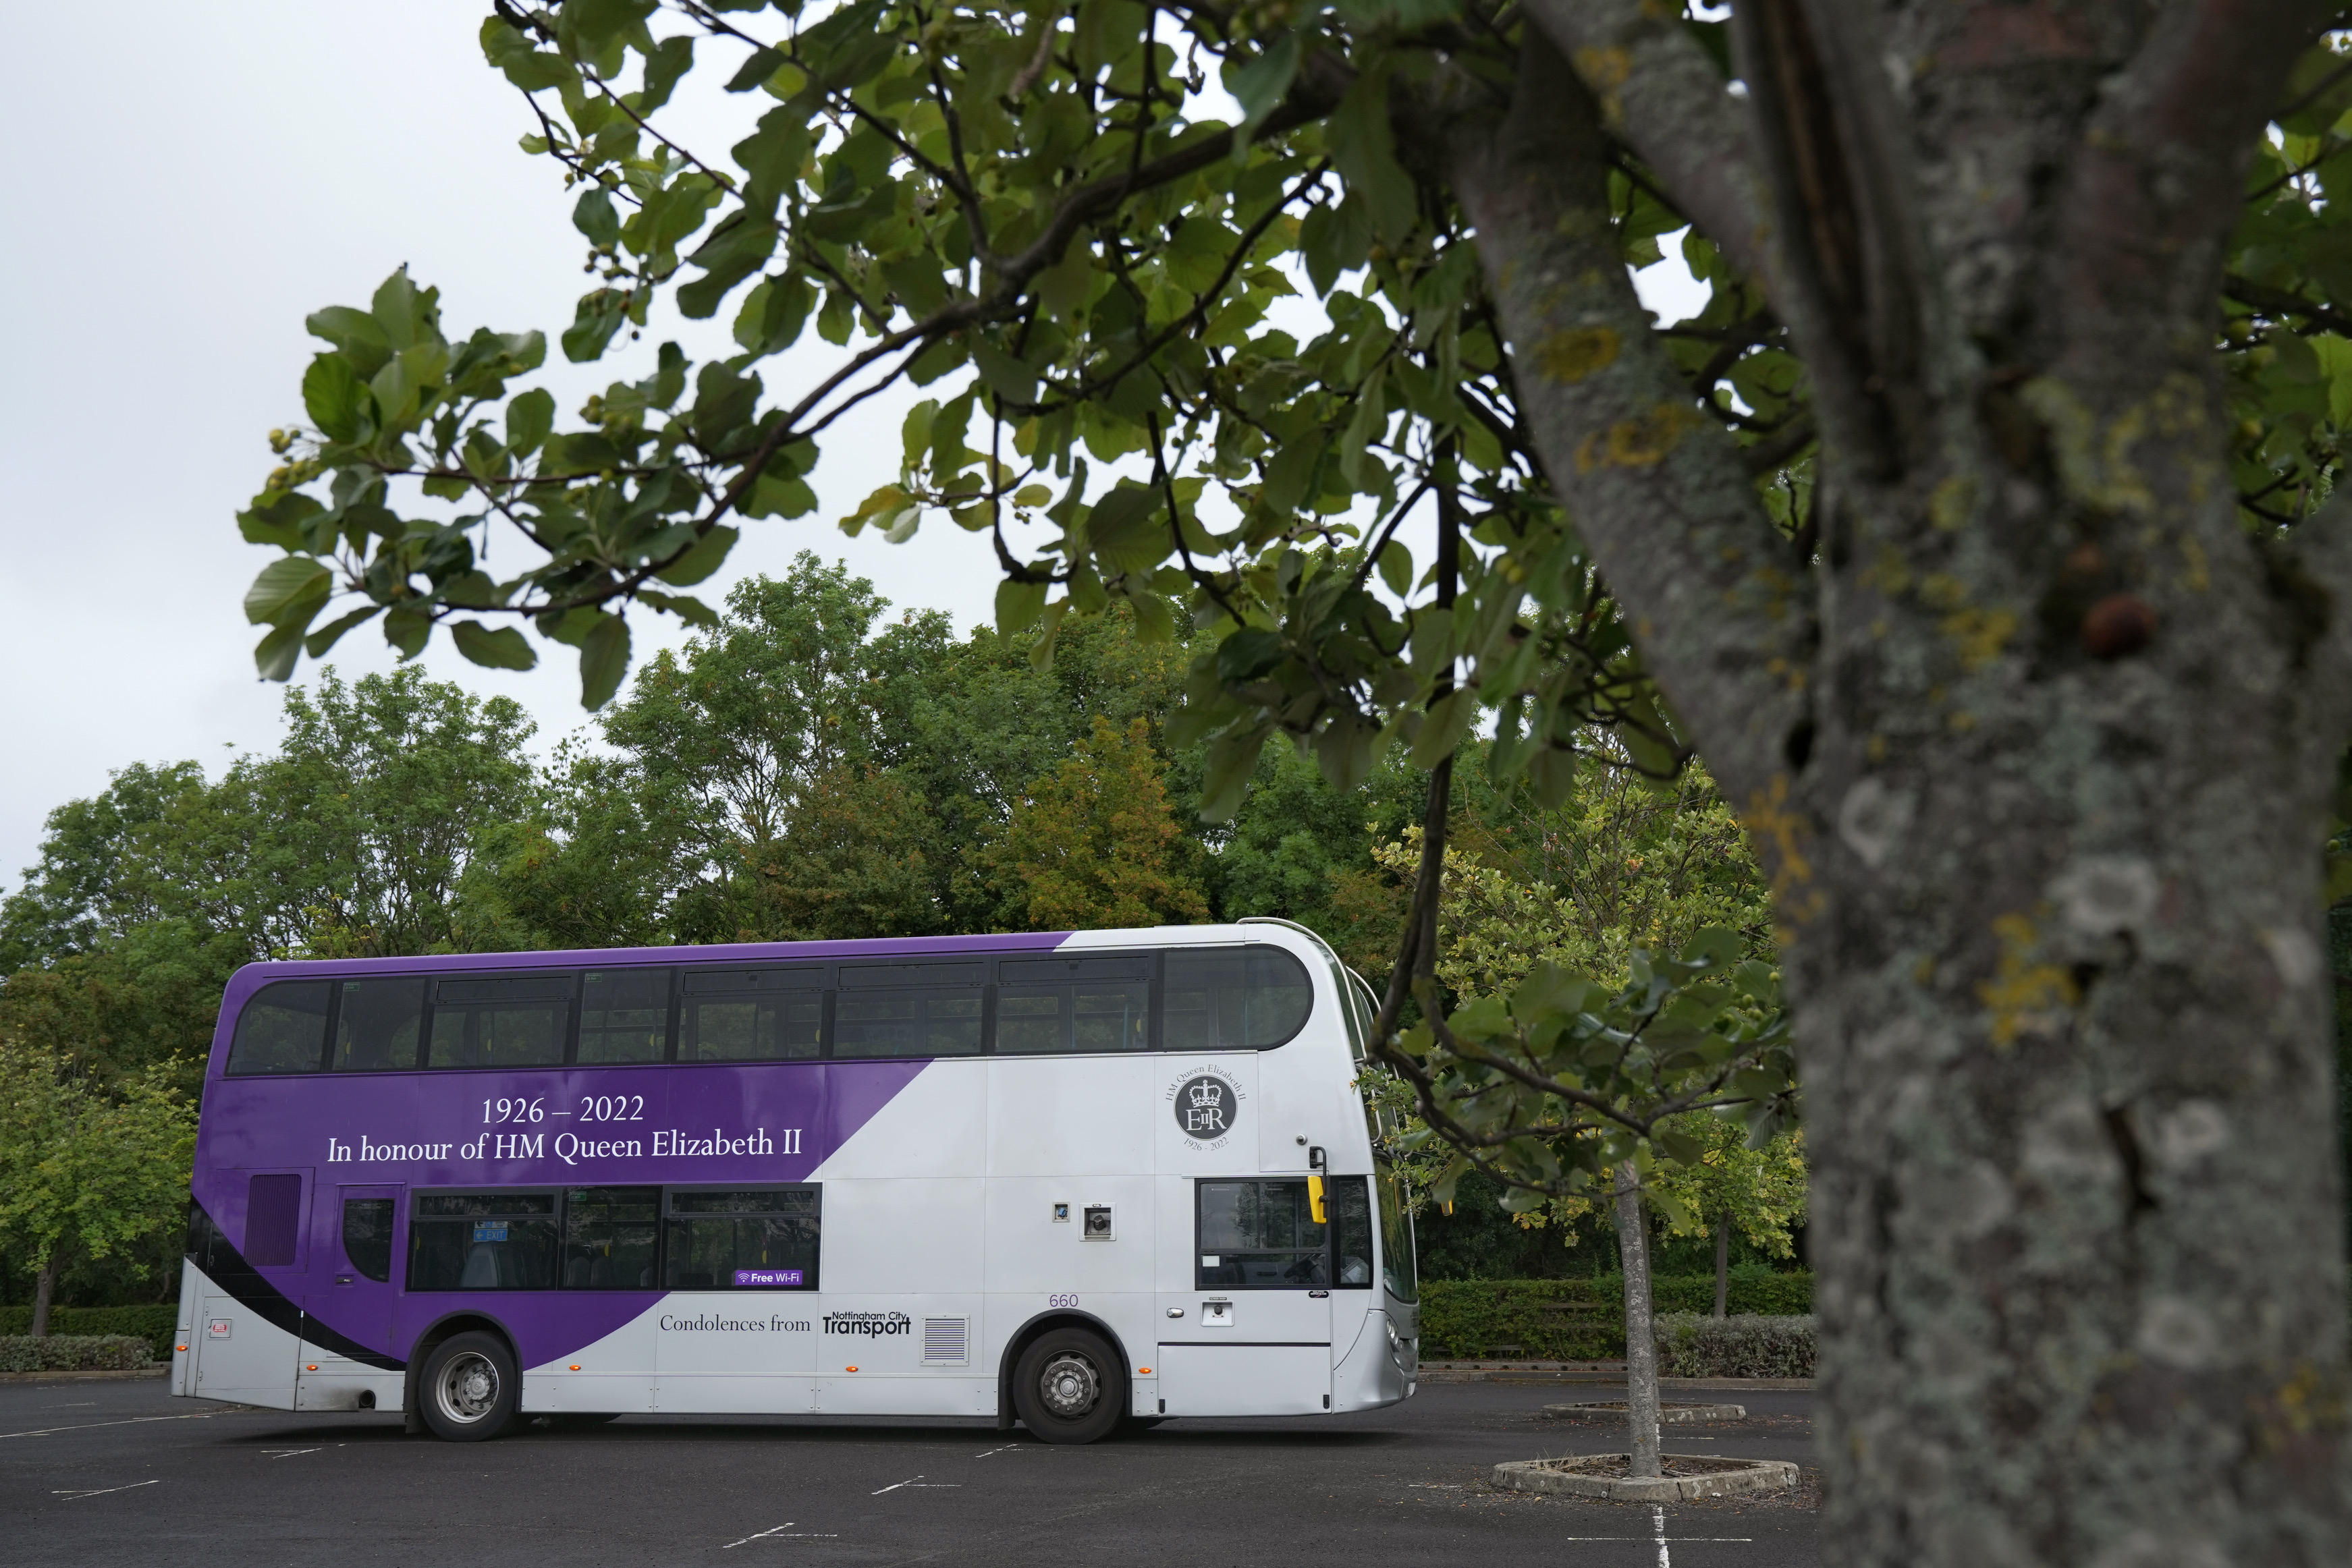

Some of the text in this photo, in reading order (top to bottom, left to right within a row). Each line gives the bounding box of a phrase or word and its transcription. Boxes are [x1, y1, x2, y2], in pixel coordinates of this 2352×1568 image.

[1166, 1064, 1247, 1101] HM Queen Elizabeth II
[483, 1098, 545, 1123] 1926
[580, 1096, 644, 1121] 2022
[327, 1128, 802, 1165] In honour of HM Queen Elizabeth II
[1184, 1138, 1202, 1151] 1926
[1210, 1137, 1229, 1151] 2022
[487, 1231, 504, 1240] EXIT
[751, 1273, 799, 1283] Free Wi-Fi
[1049, 1293, 1078, 1308] 660
[660, 1314, 811, 1332] Condolences from
[832, 1312, 906, 1322] Nottingham City
[823, 1316, 911, 1339] Transport
